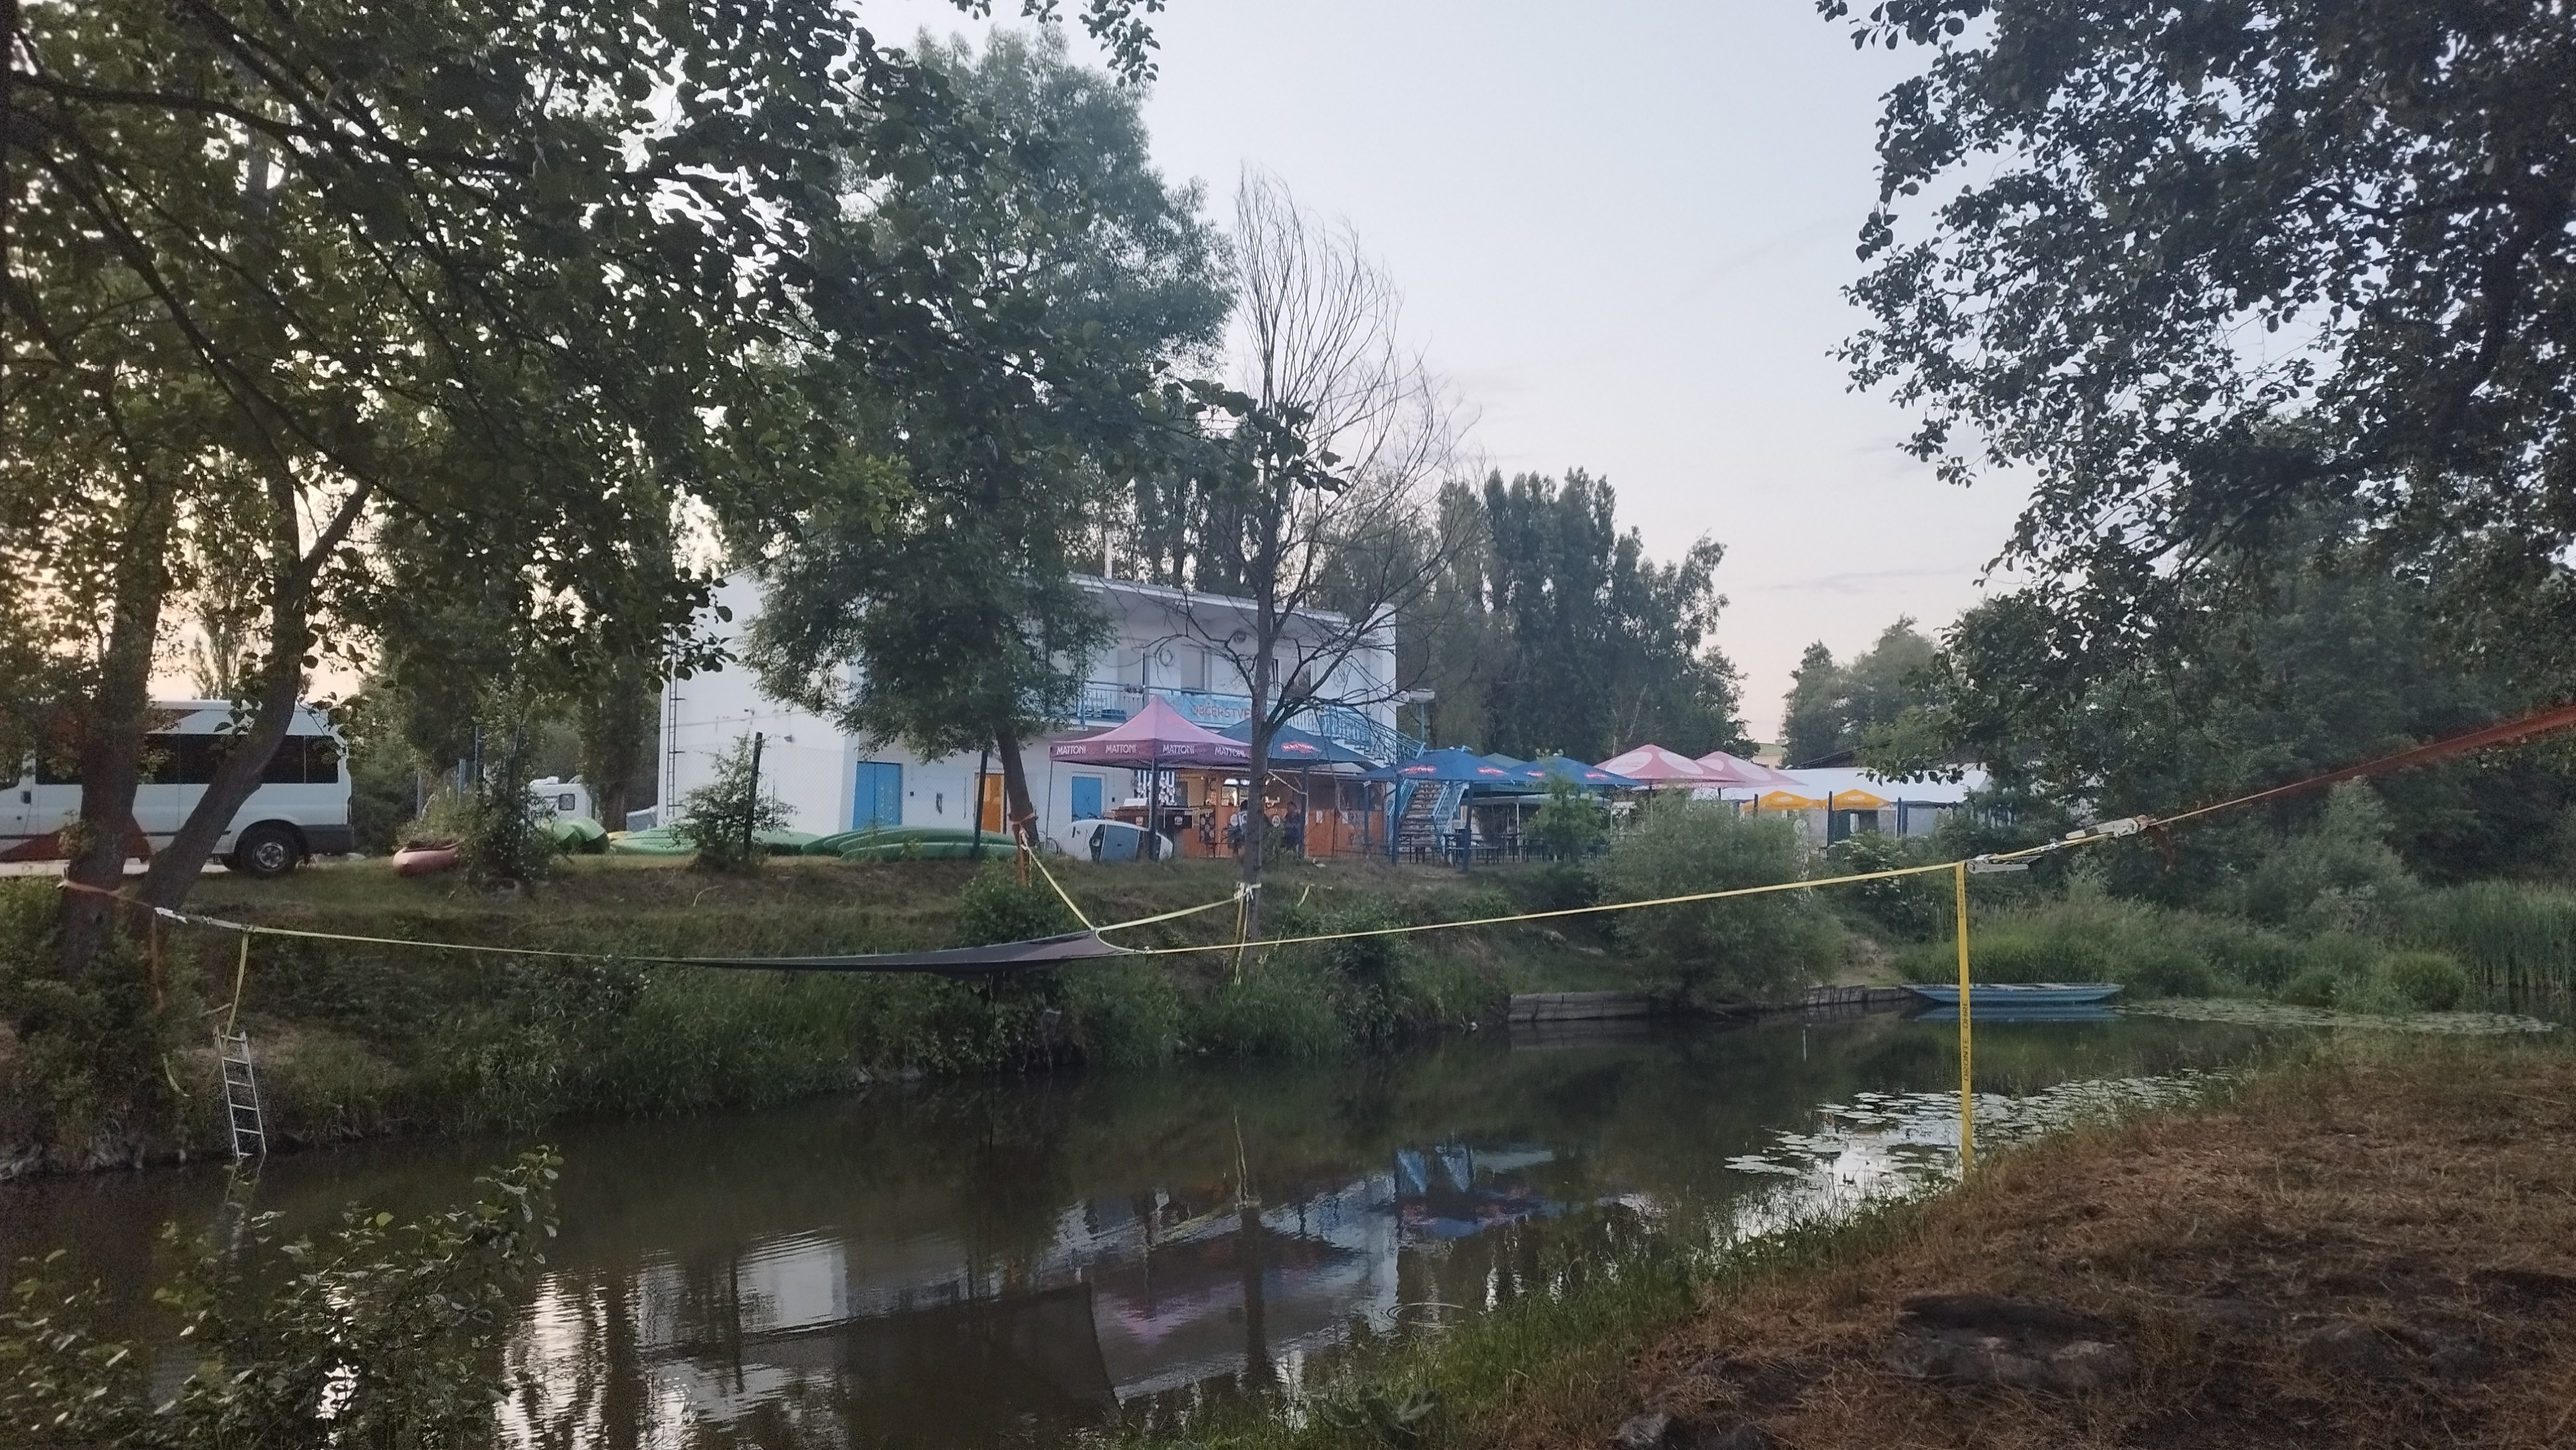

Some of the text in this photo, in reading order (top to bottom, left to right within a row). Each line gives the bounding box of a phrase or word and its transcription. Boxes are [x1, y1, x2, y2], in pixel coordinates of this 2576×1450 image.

[1191, 702, 1251, 719] OBČERSTVE
[1056, 744, 1136, 755] MATTONI MATTONI
[1162, 744, 1194, 754] MATTONI
